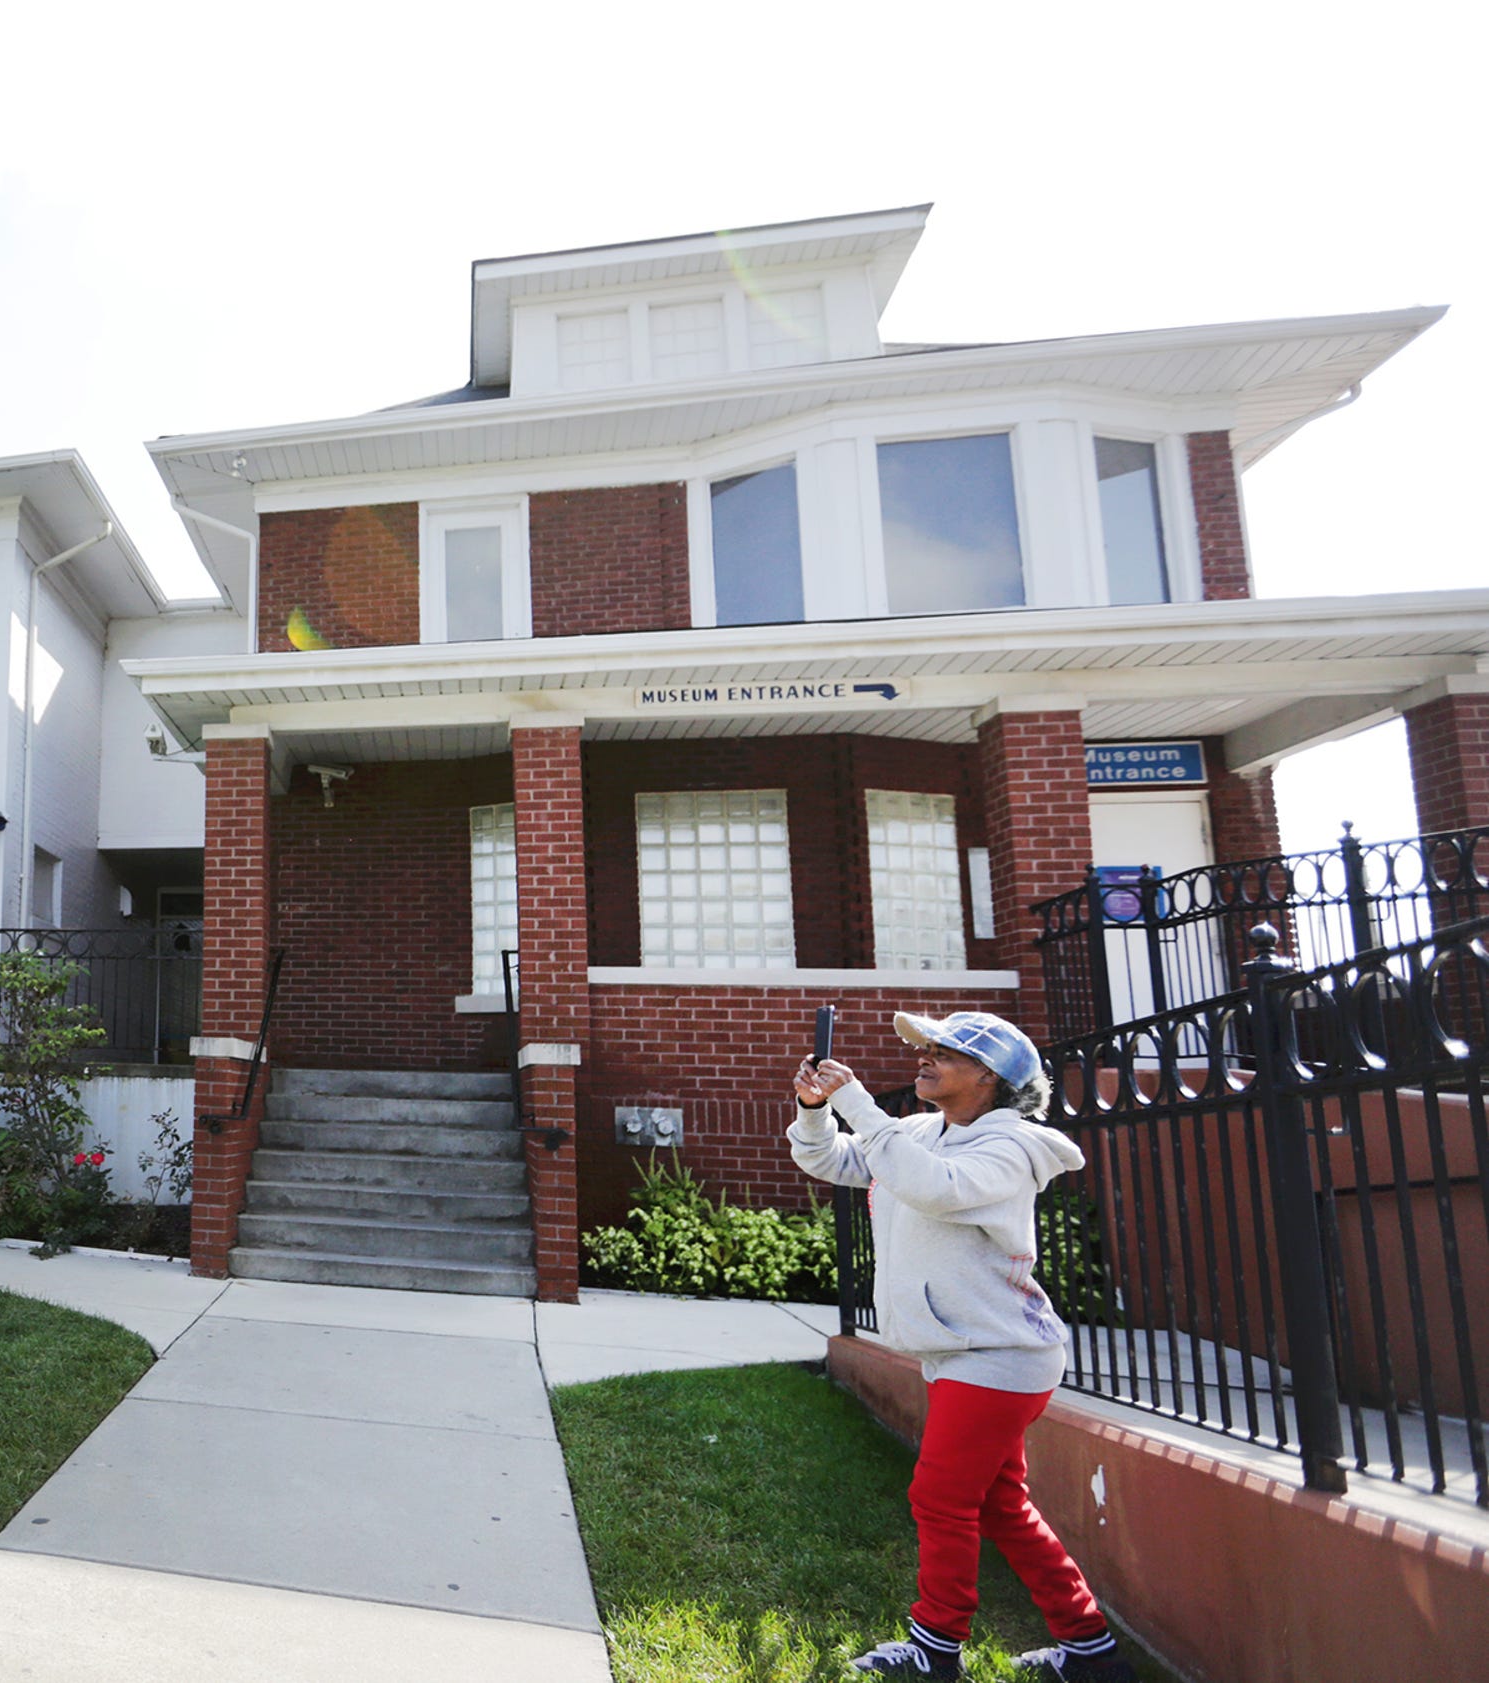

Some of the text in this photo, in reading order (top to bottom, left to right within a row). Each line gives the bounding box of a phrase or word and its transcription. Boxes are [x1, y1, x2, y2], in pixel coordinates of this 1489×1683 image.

[642, 683, 847, 704] MUSEUM ENTRANCE
[1089, 766, 1186, 780] ntrance
